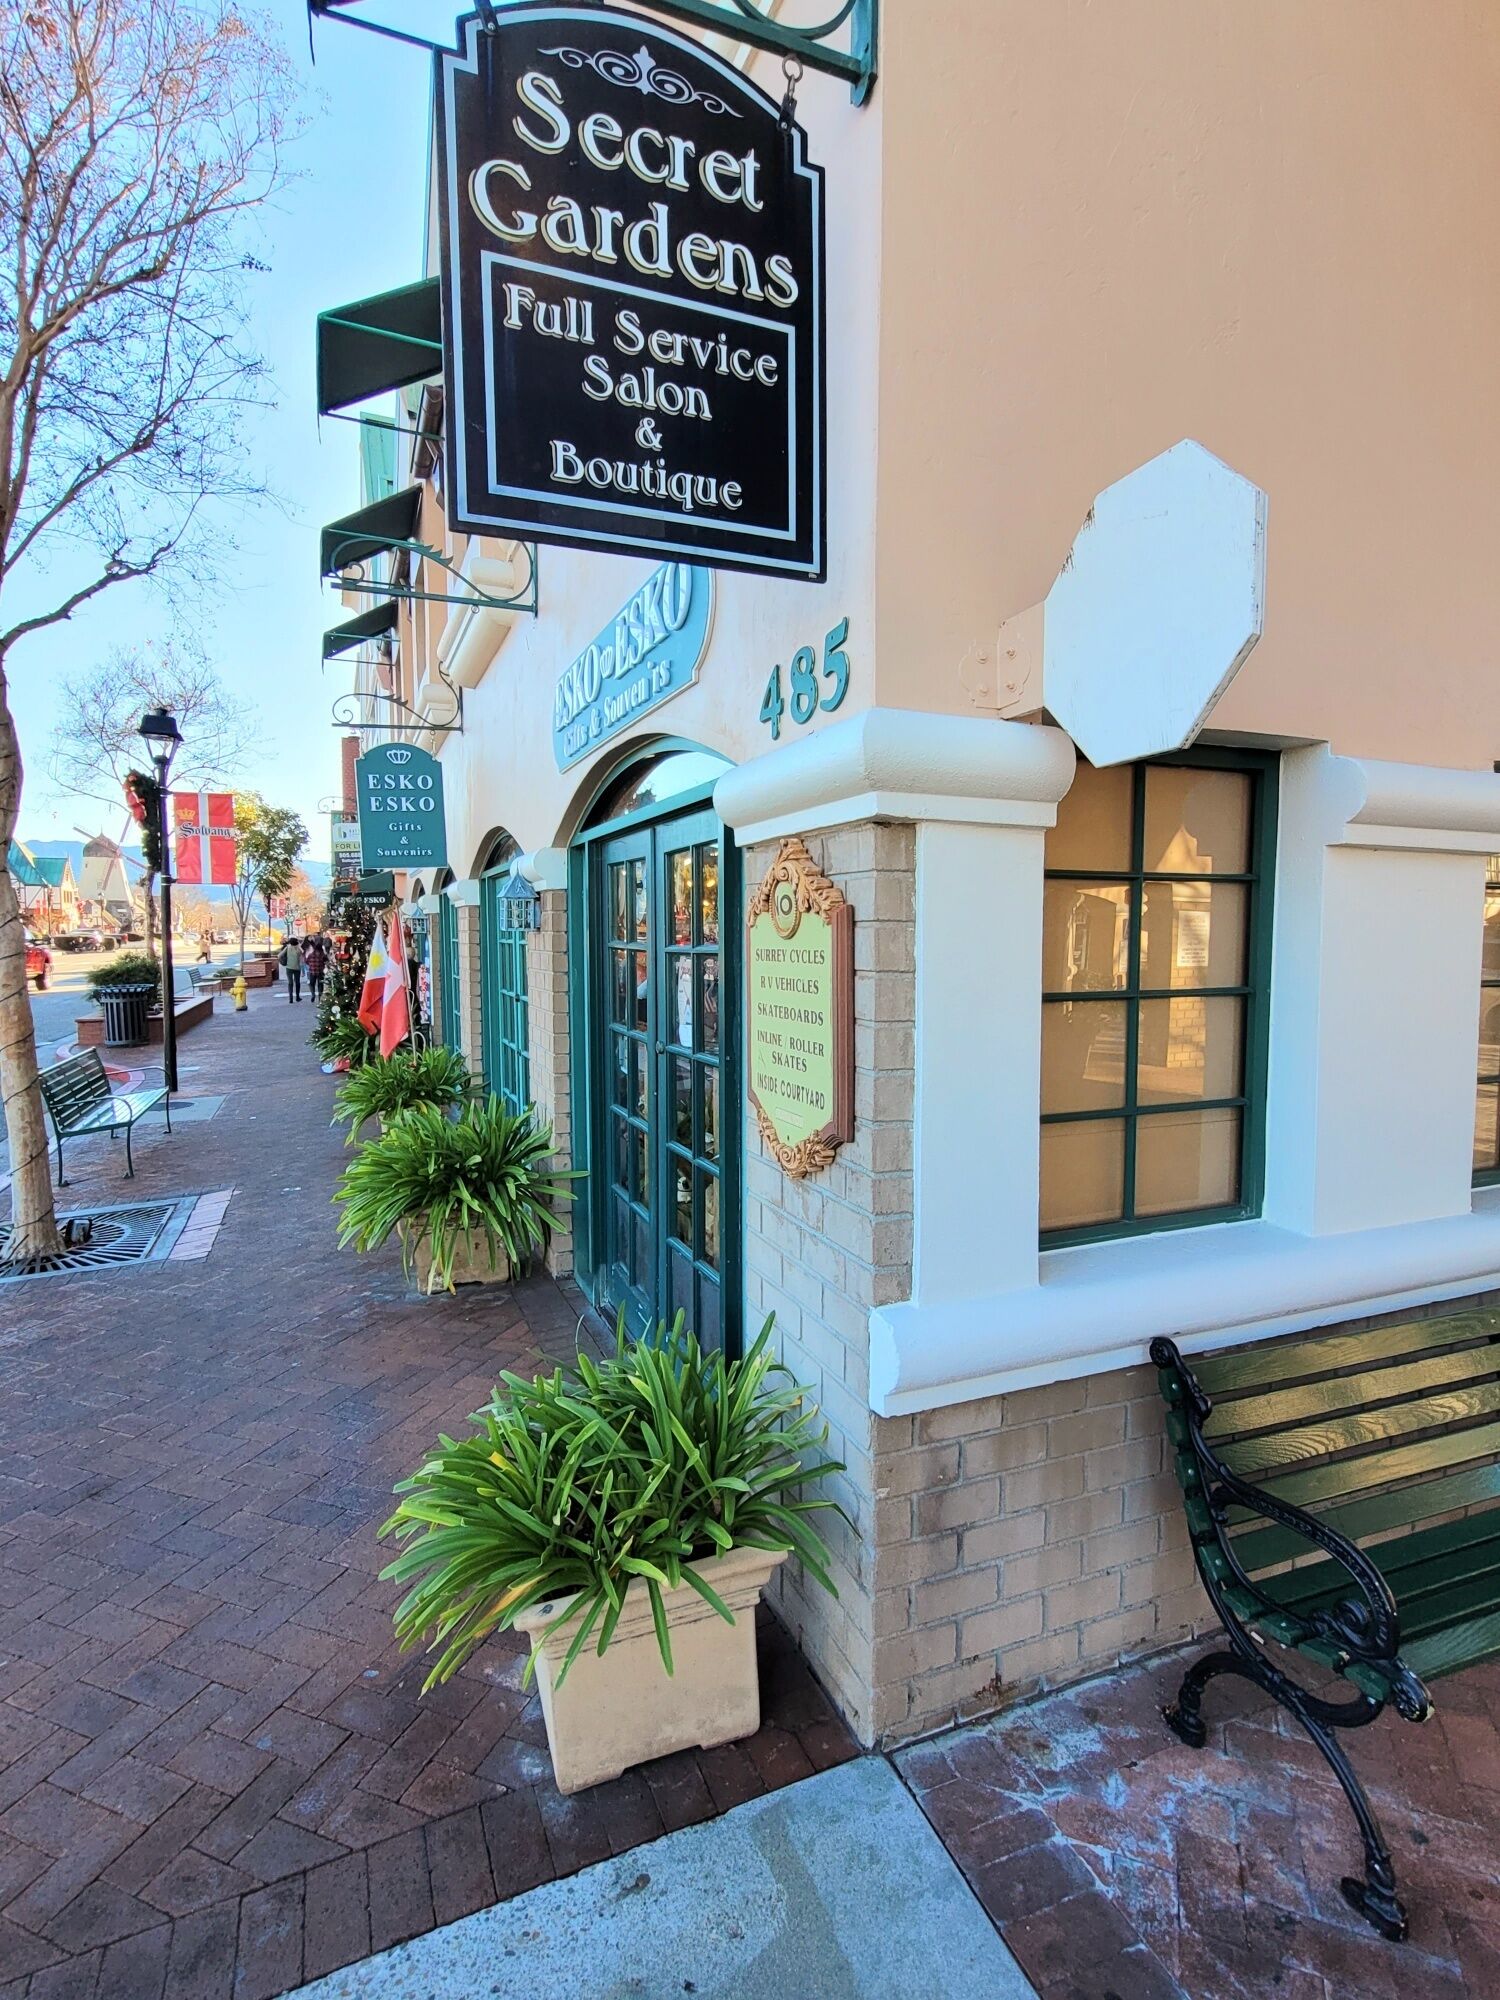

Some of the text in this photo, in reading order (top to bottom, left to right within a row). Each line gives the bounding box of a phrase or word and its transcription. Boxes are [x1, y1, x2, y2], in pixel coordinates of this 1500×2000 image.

[514, 72, 763, 211] Secret
[468, 159, 800, 309] Gardens
[502, 282, 779, 387] Full Service
[582, 355, 713, 421] Salon
[635, 417, 663, 451] &
[549, 439, 744, 511] Boutique
[555, 562, 693, 733] ESKO ESKO
[760, 617, 850, 740] 485
[588, 708, 603, 739] &
[368, 774, 433, 790] ESKO
[370, 796, 435, 812] ESKO
[180, 821, 232, 838] Solvang
[388, 822, 423, 832] Gifts
[400, 836, 409, 845] &
[377, 847, 433, 857] Souvenirs
[755, 948, 826, 965] SURREY CYCLES
[775, 977, 820, 995] VEHICLES
[757, 1002, 825, 1027] SKATEBOARDS
[757, 1029, 783, 1048] INLINE
[789, 1036, 825, 1058] ROLLER
[771, 1050, 808, 1073] SKATES
[757, 1071, 826, 1111] INSIDE COURTYARD
